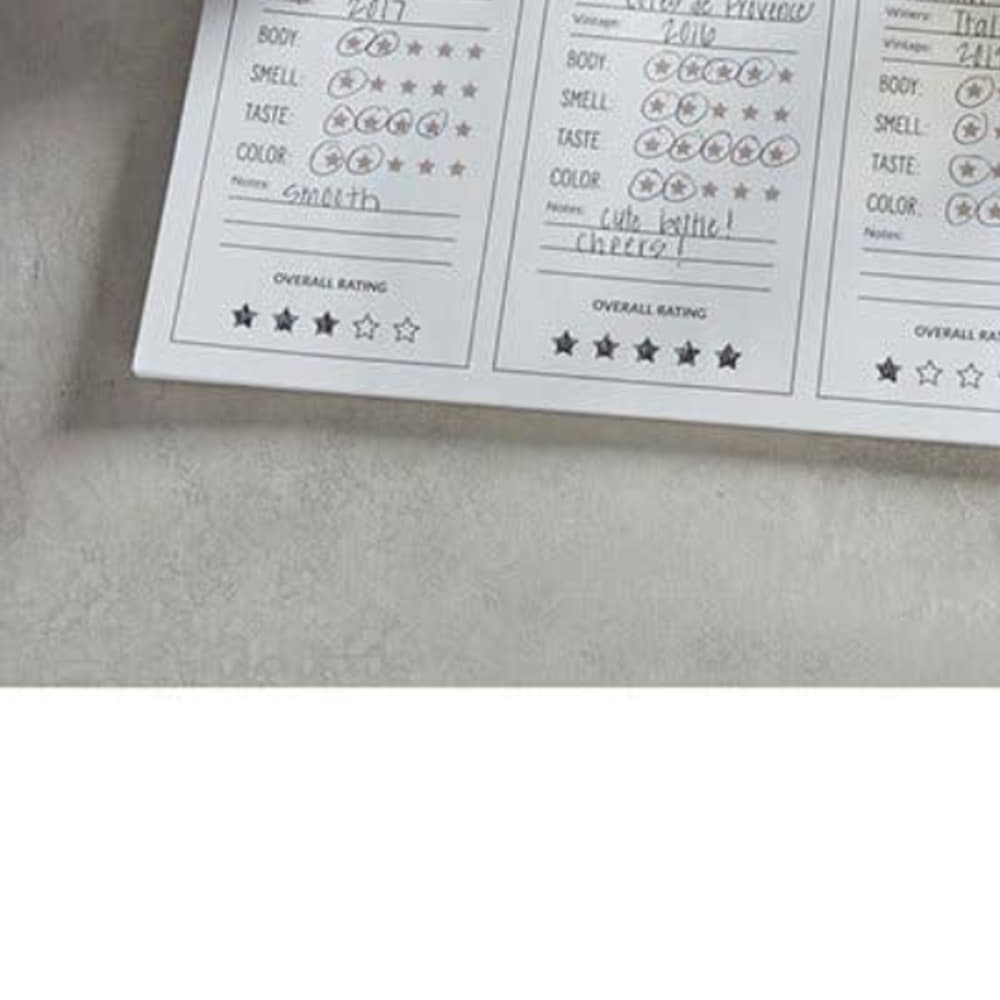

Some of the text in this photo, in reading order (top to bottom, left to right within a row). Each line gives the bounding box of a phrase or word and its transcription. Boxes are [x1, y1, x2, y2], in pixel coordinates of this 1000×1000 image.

[272, 271, 388, 294] OVERALL RATING
[592, 299, 707, 321] OVERALL RATING
[914, 324, 975, 341] OVERALL
